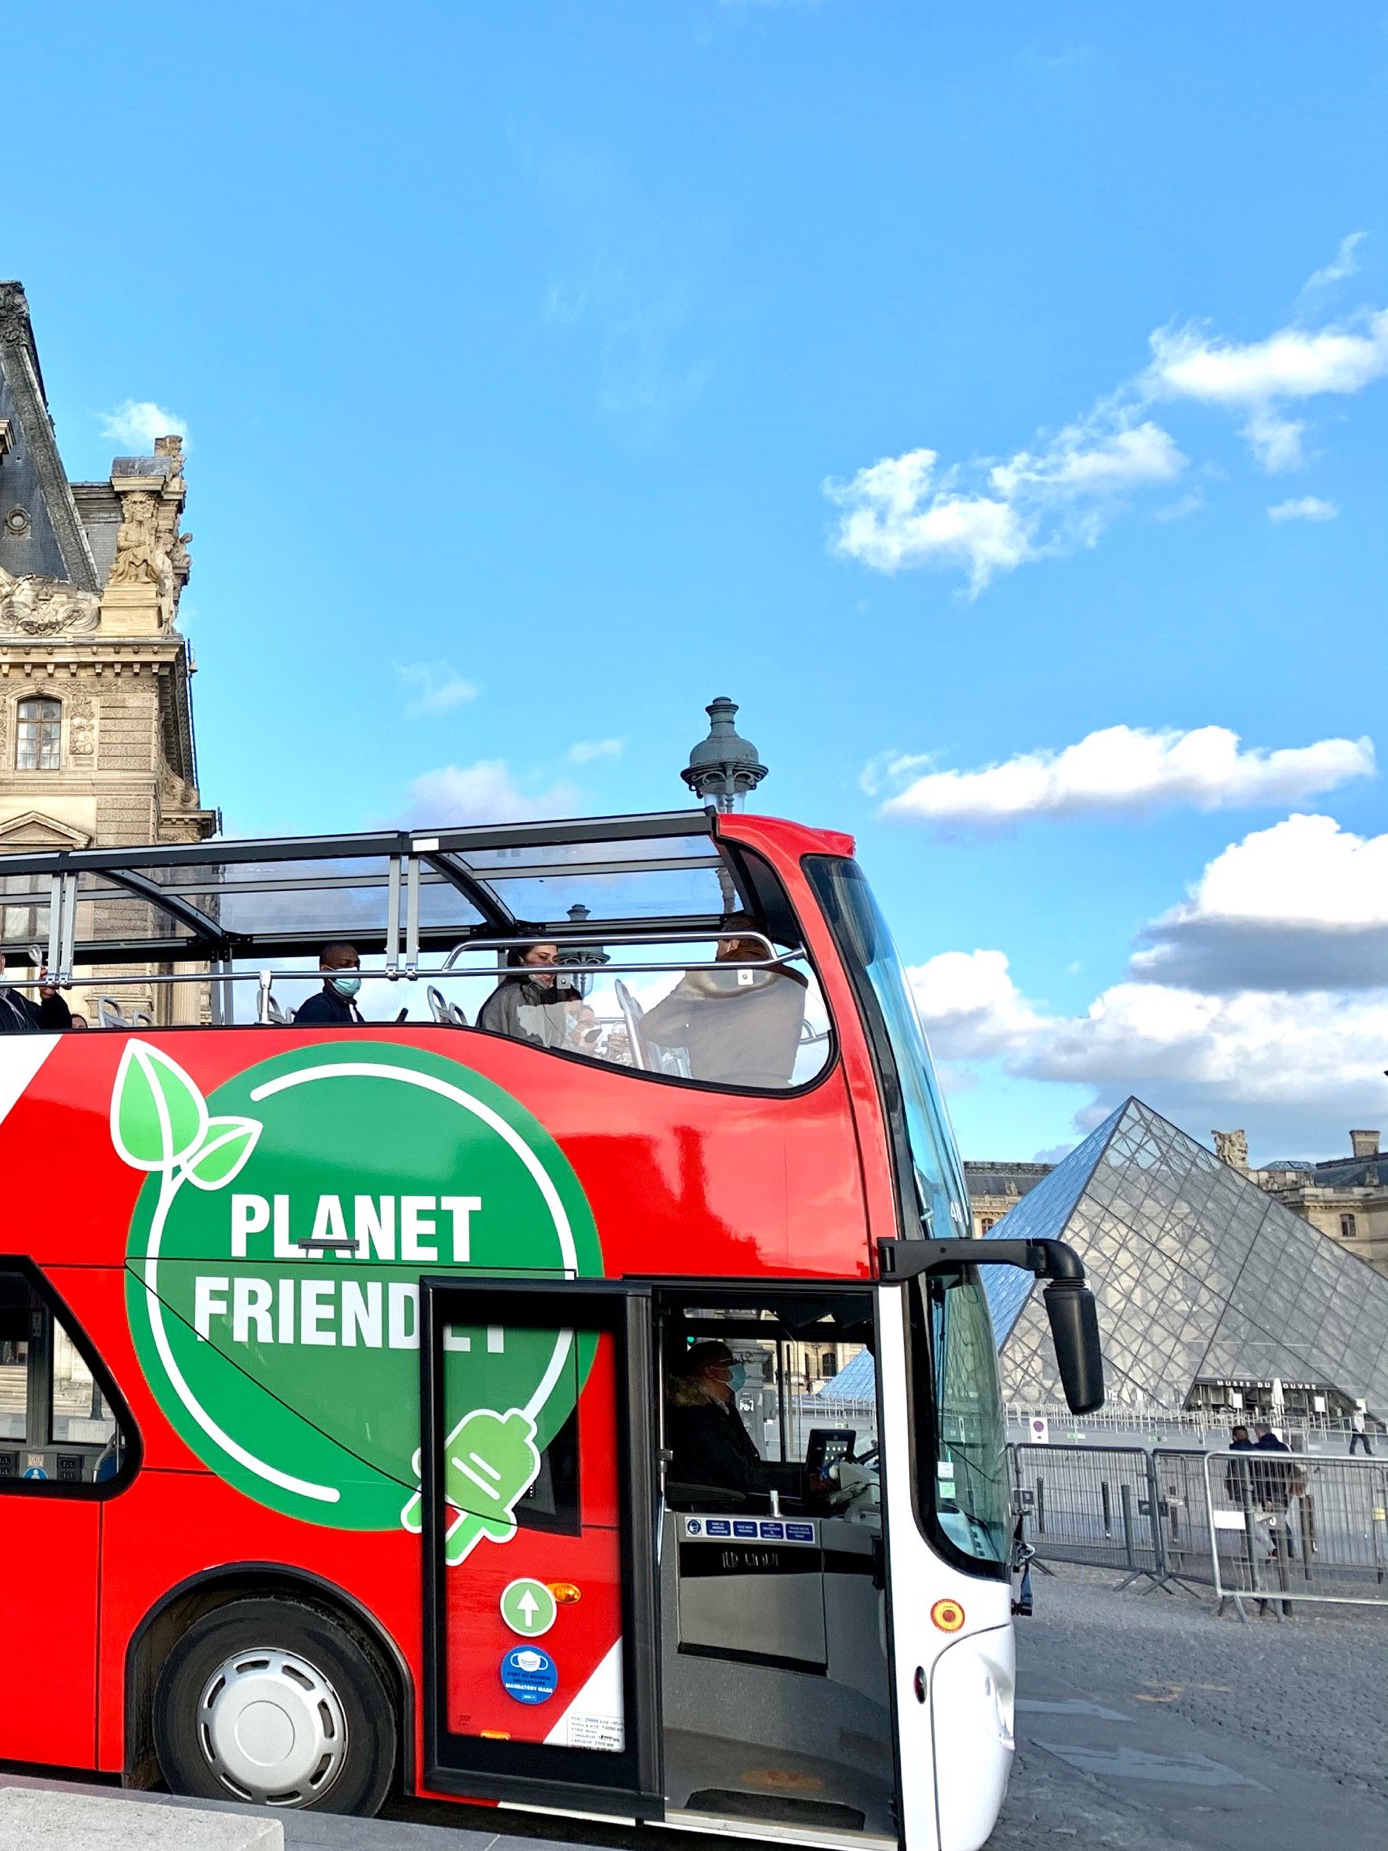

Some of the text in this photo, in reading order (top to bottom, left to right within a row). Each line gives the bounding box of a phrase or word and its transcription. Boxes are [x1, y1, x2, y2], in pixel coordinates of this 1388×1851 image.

[230, 1193, 482, 1263] PLANET
[194, 1276, 505, 1353] FRIEND
[1283, 1382, 1317, 1390] OUVRE
[505, 1682, 537, 1691] MANDATORY
